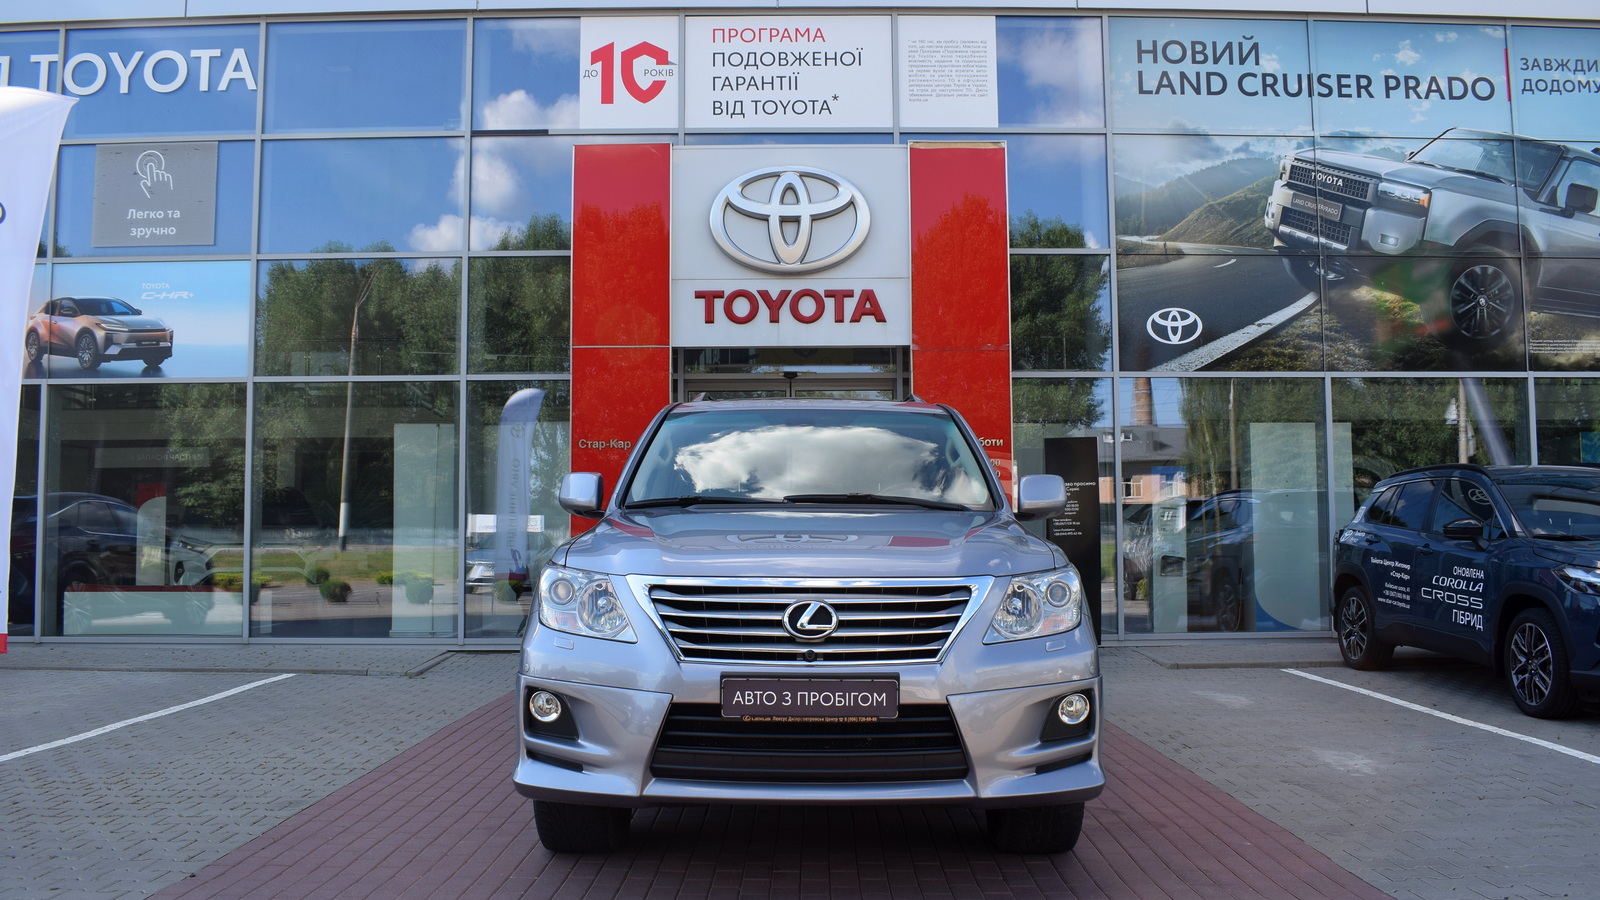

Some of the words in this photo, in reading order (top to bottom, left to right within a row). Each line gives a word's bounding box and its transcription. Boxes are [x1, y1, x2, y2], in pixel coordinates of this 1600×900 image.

[712, 28, 826, 43] ПРОГРАМА
[712, 47, 864, 71] ПОДОВЖЕНОЇ
[1136, 35, 1261, 66] НОВИЙ
[30, 48, 257, 96] TOYOTA
[583, 69, 599, 79] ДО
[643, 68, 675, 78] РОКІВ
[1519, 57, 1599, 75] ЗАВЖДИ
[712, 72, 800, 92] ГАРАНТІЇ
[1137, 70, 1228, 96] LAND
[1237, 71, 1374, 99] CRUISER
[1385, 74, 1496, 102] PRADO
[712, 100, 746, 119] ВІД
[1311, 172, 1343, 187] TOYOTA
[127, 208, 164, 221] Легко
[168, 209, 181, 219] та
[130, 225, 177, 238] зручно
[694, 288, 887, 325] TOYOTA
[578, 437, 632, 451] Стар-Кар
[978, 437, 1004, 447] боти
[1452, 565, 1485, 580] ОНОВЛЕНА
[1432, 575, 1484, 593] COROLLA
[1421, 587, 1483, 610] CROSS
[1452, 609, 1484, 632] ГІБРИД
[732, 691, 777, 706] АВТО
[797, 692, 887, 707] ПРОБІГОМ
